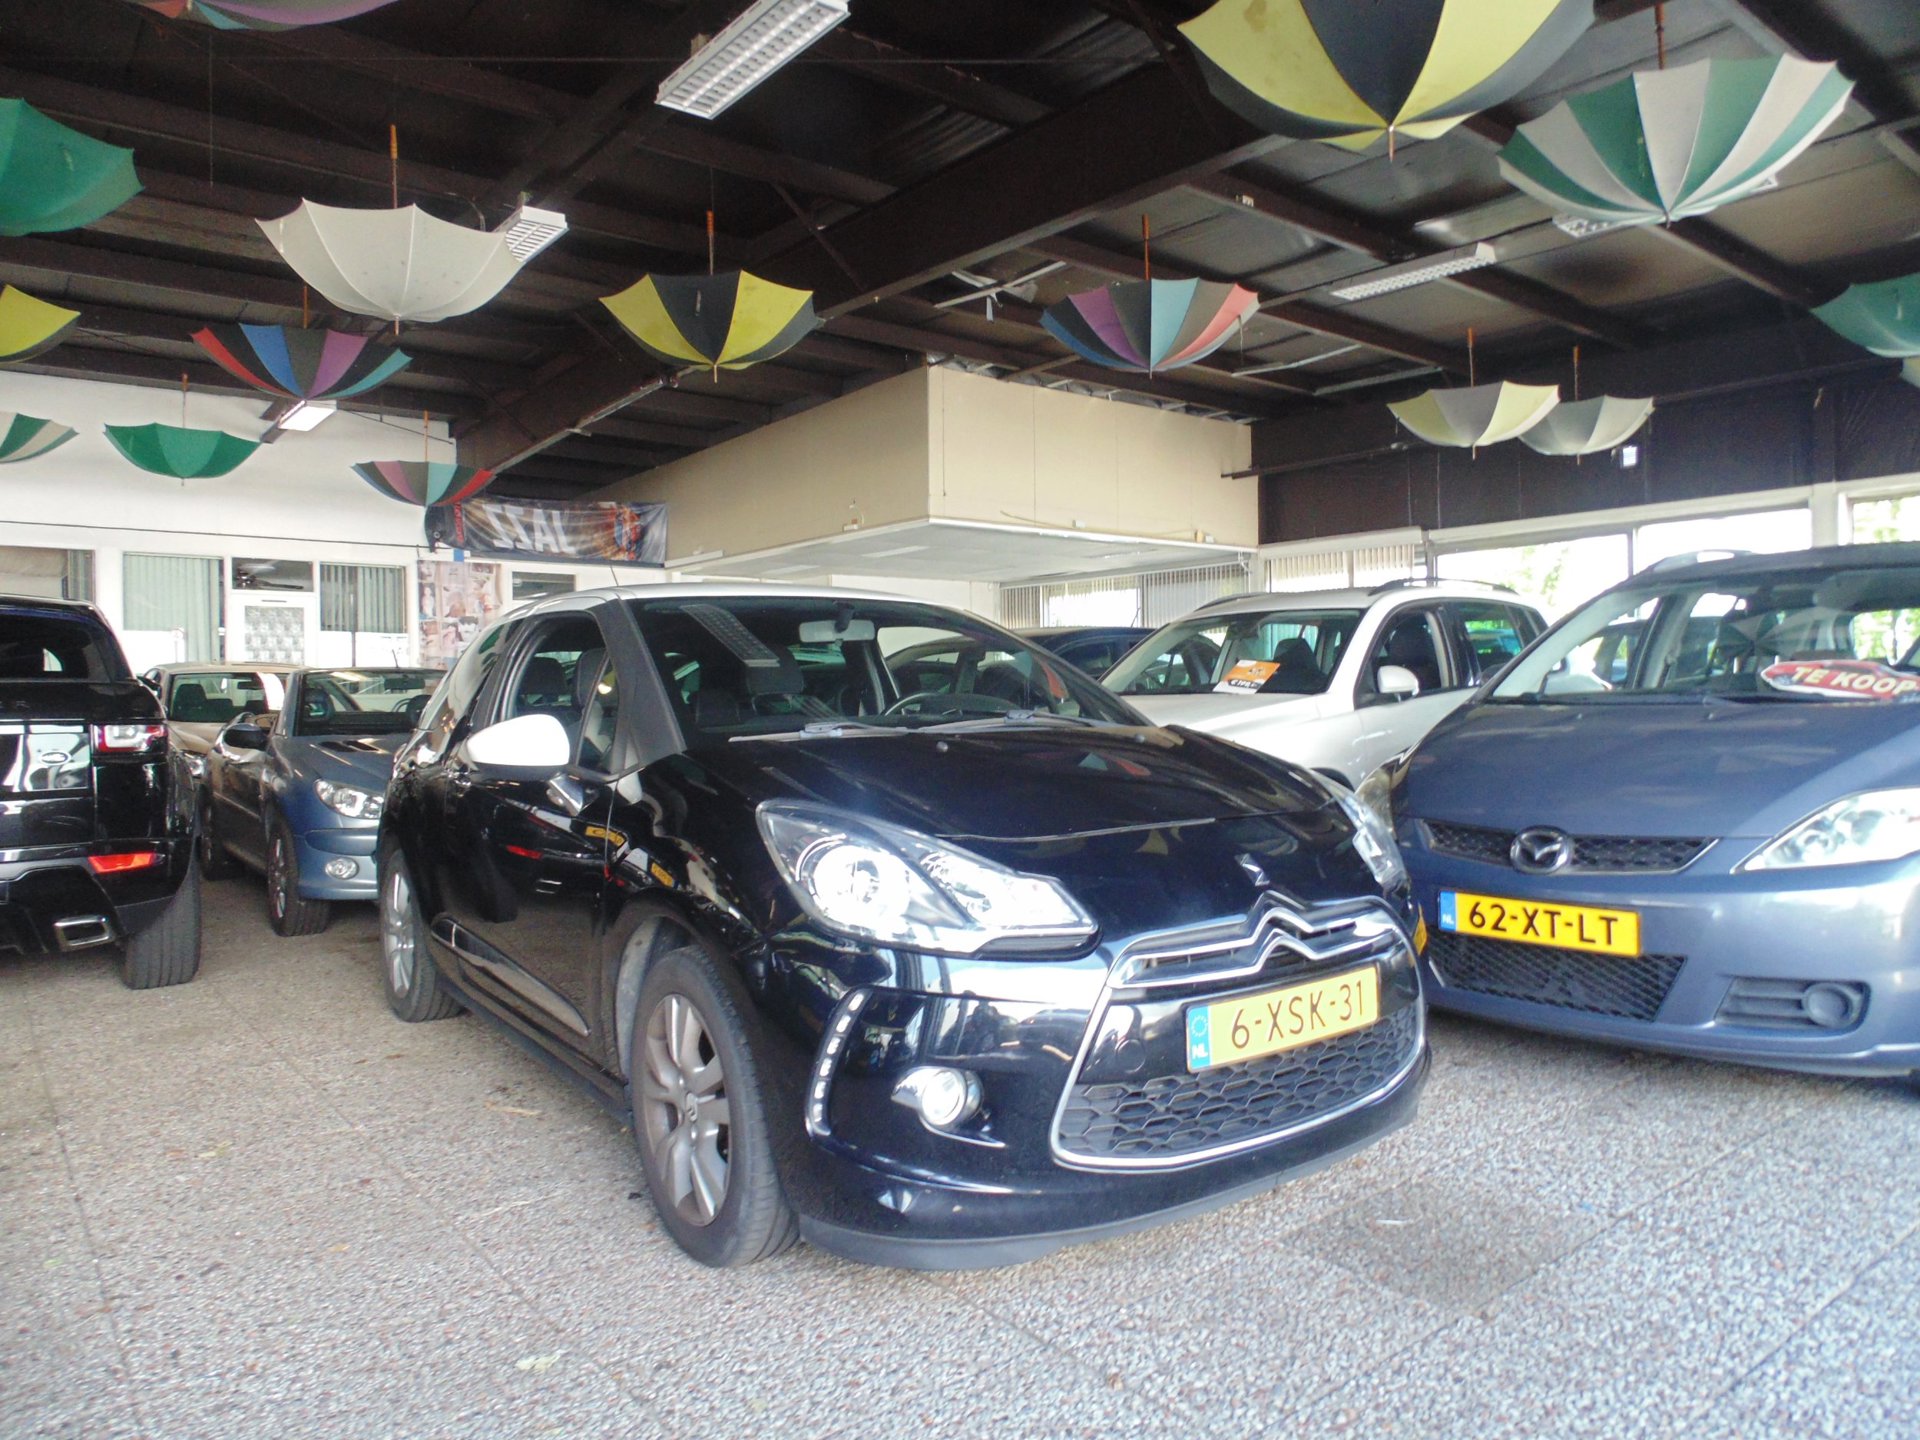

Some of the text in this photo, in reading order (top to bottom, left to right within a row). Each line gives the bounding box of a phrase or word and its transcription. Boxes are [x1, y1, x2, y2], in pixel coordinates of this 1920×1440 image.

[1791, 667, 1917, 696] TE KOOP
[1441, 913, 1454, 925] NL
[1469, 901, 1618, 946] 62-XT-LT
[1231, 979, 1363, 1050] 6-XSK-31
[1191, 1043, 1208, 1060] NL
